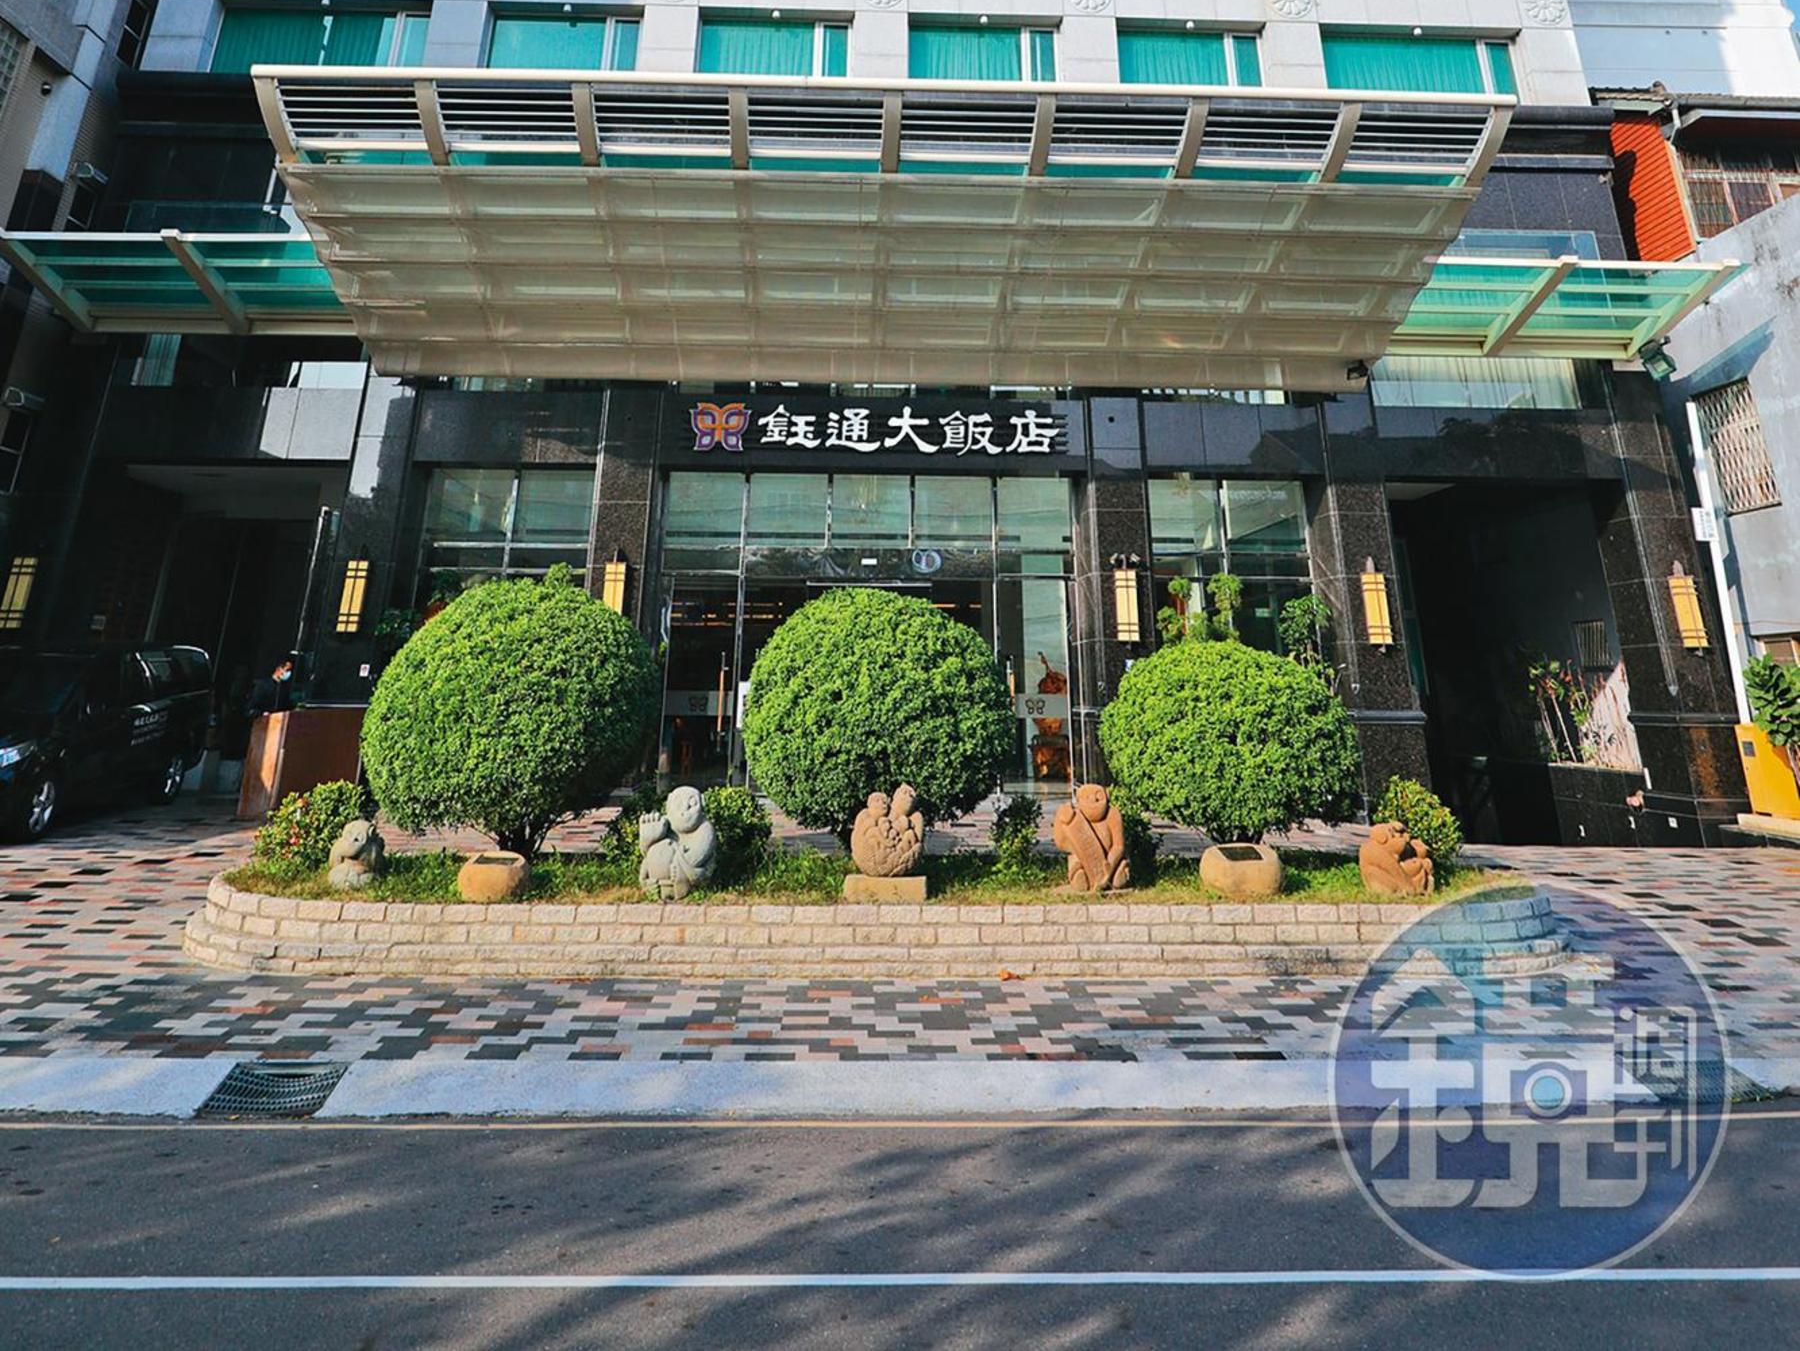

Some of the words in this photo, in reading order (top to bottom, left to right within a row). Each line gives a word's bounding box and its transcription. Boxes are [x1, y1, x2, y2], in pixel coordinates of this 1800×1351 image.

[757, 403, 1060, 456] 鈺通大飯店
